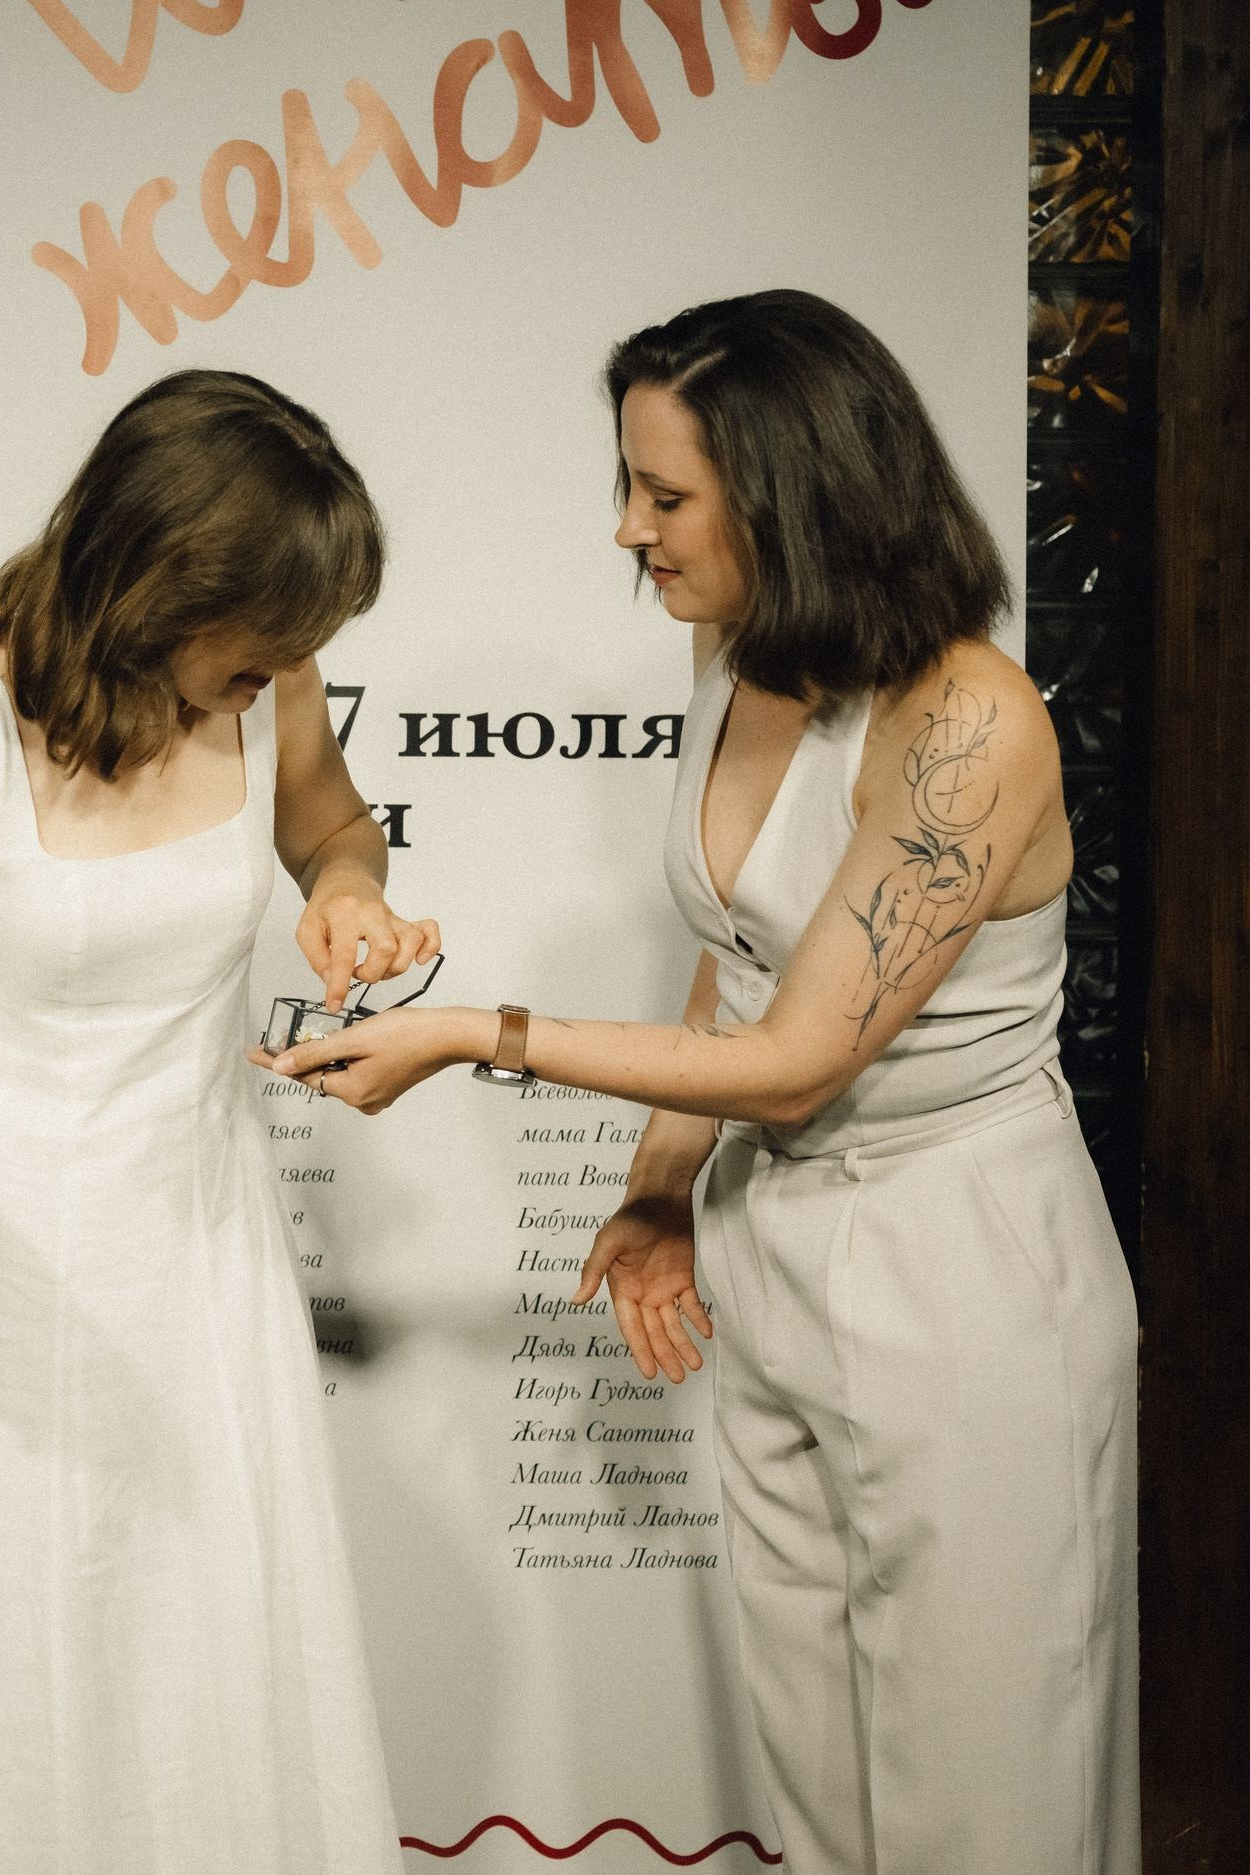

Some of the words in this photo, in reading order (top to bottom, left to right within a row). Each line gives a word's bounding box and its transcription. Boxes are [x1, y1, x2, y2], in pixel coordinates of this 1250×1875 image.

[398, 712, 685, 760] июля
[517, 1126, 586, 1143] мама
[517, 1169, 570, 1186] папа
[578, 1164, 630, 1187] Вова
[513, 1293, 608, 1321] Марина
[512, 1335, 577, 1363] Дядя
[513, 1378, 581, 1406] Игорь
[589, 1378, 664, 1407] Гудков
[511, 1420, 577, 1442] Женя
[586, 1420, 695, 1443] Саютина
[511, 1463, 582, 1485] Маша
[590, 1463, 689, 1485] Ладнова
[509, 1505, 626, 1533] Дмитрий
[633, 1505, 720, 1527] Ладнов
[513, 1547, 613, 1569] Татьяна
[620, 1547, 719, 1569] Ладнова
